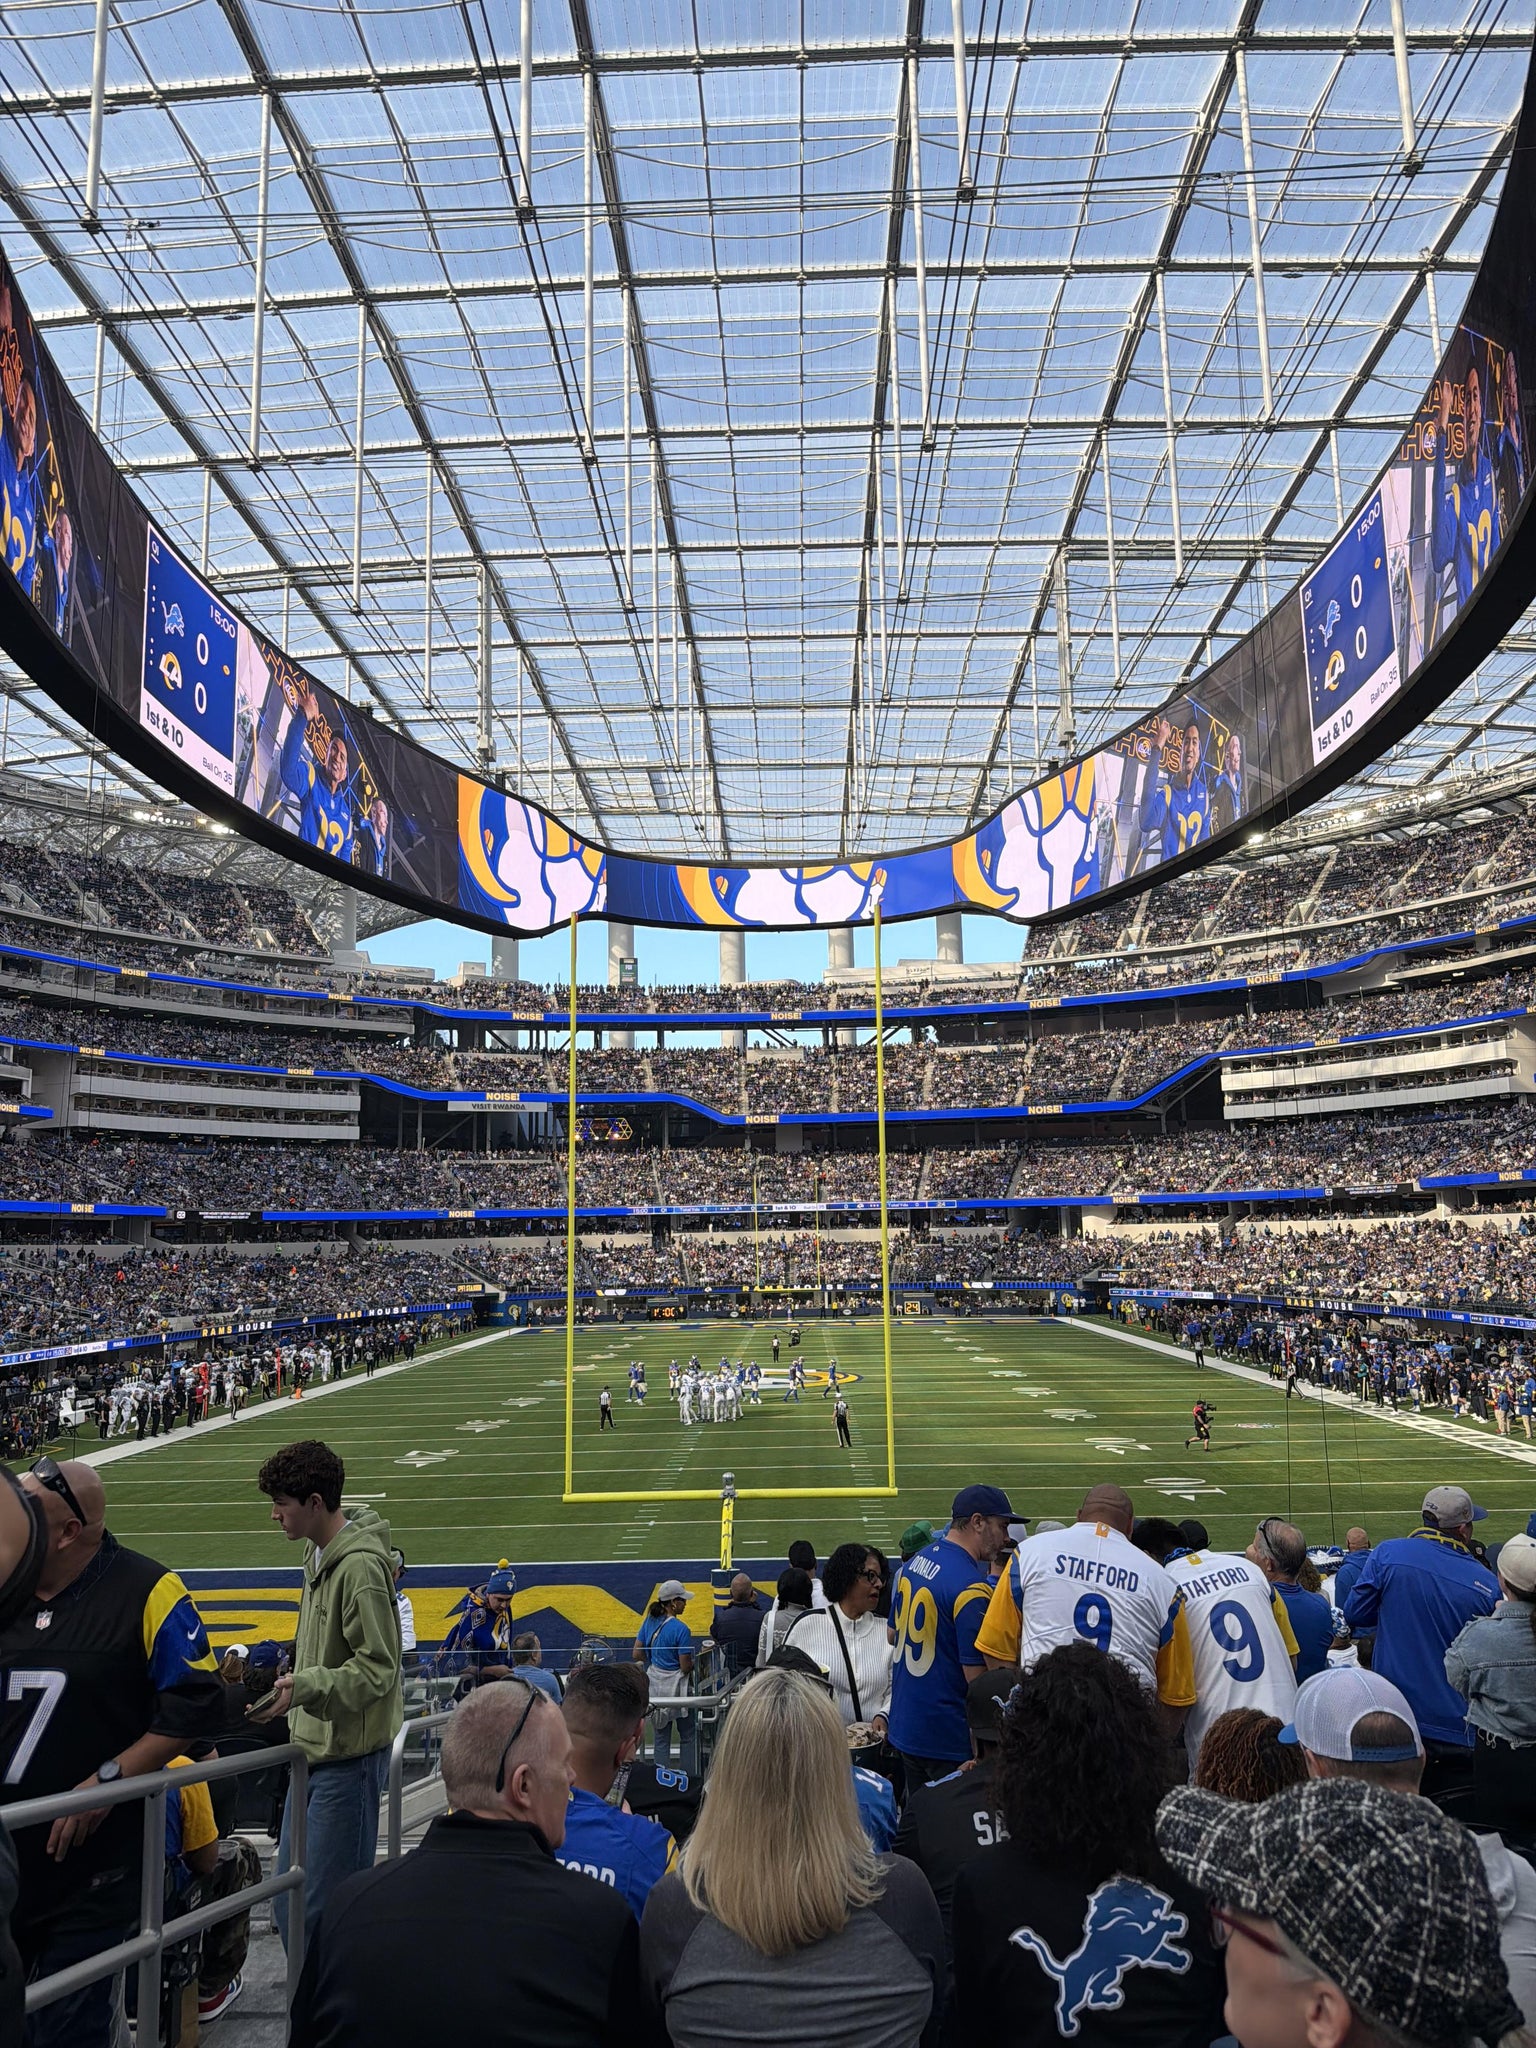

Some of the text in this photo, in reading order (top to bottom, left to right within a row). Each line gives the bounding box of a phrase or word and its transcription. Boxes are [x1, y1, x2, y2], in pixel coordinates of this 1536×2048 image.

[1401, 421, 1465, 462] HOUS
[1357, 501, 1381, 542] 15:00
[1351, 574, 1363, 609] 0
[210, 604, 237, 639] 15:00
[1355, 625, 1368, 660] 0
[196, 632, 210, 667] 0
[1389, 665, 1398, 682] 35
[194, 681, 207, 715] 0
[146, 702, 184, 749] 1st & 10
[1317, 709, 1354, 753] 1st & 10
[1114, 732, 1182, 773] HOUS
[203, 757, 213, 774] Ball
[223, 768, 233, 787] 35
[1475, 923, 1500, 935] NOISE!
[121, 968, 148, 978] NOISE!
[1247, 973, 1282, 985] NOISE!
[328, 993, 353, 1001] NOISE!
[1030, 999, 1061, 1009] NOISE!
[513, 1012, 544, 1021] NOISE!
[771, 1012, 802, 1020] NOISE!
[1315, 1037, 1340, 1046] NOISE!
[79, 1046, 105, 1056] NOISE!
[288, 1068, 314, 1076] NOISE!
[486, 1092, 520, 1101] NOISE!
[0, 1103, 20, 1113] OISE!
[1028, 1104, 1062, 1115] NOISE!
[746, 1114, 779, 1124] NOISE!
[1499, 1171, 1523, 1181] NOISE!
[1113, 1196, 1140, 1204] NOISE!
[71, 1203, 95, 1213] NOISE!
[449, 1210, 475, 1218] NOISE!
[905, 1303, 920, 1313] 24
[1286, 1298, 1353, 1311] RAMS HOUSE
[336, 1306, 408, 1320] RAMS HOUSE
[202, 1321, 273, 1337] RAMS HOUSE
[908, 1555, 942, 1581] DONALD
[1054, 1554, 1139, 1593] STAFFORD
[893, 1577, 938, 1677] 99
[1072, 1593, 1113, 1652] 9
[1210, 1600, 1265, 1683] 9
